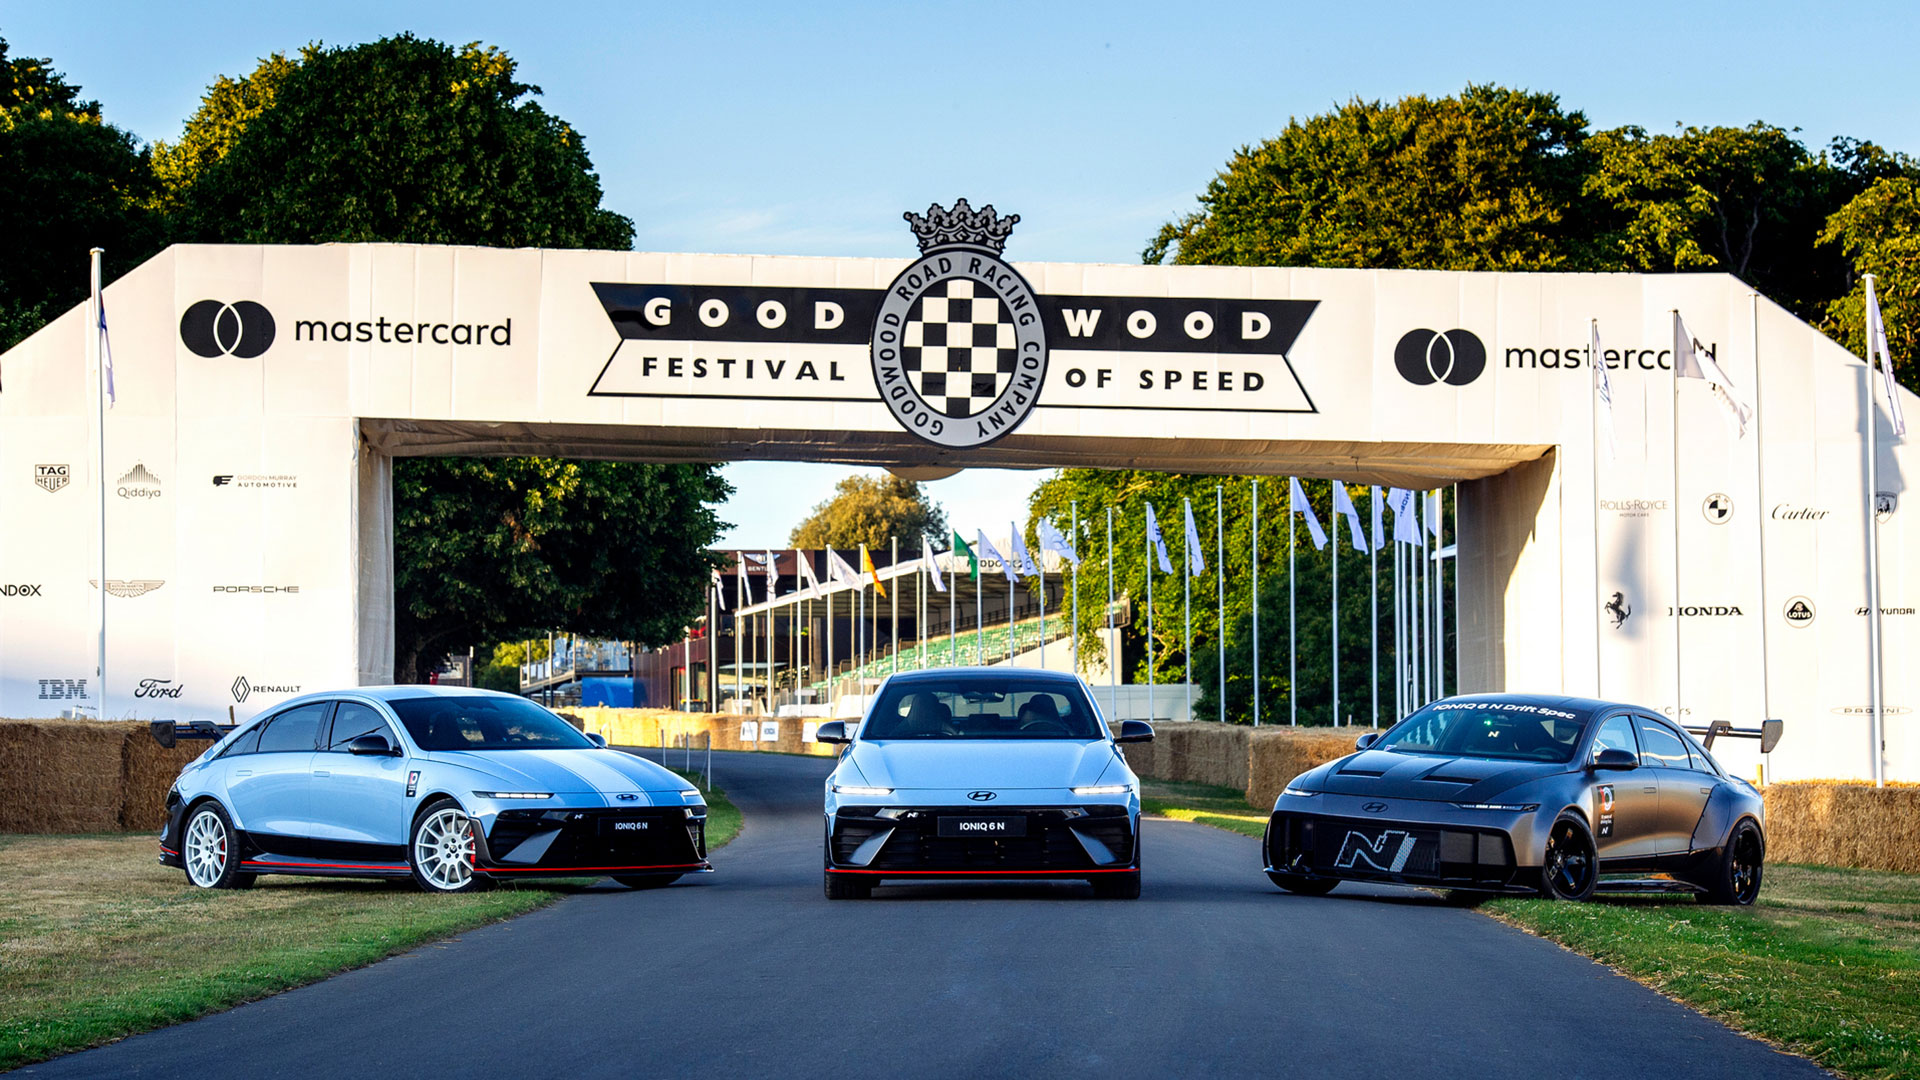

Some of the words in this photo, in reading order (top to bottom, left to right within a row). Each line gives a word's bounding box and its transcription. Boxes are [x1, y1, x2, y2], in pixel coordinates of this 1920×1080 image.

[896, 257, 951, 302] ROAD
[968, 257, 1035, 327] RACING
[643, 297, 845, 330] GOOD
[295, 317, 512, 346] mastercard
[1061, 309, 1272, 340] WOOD
[642, 357, 845, 381] FESTIVAL
[879, 313, 943, 436] GOODWOOD
[1065, 368, 1112, 388] OF
[1139, 369, 1264, 392] SPEED
[976, 341, 1040, 438] COMPANY
[38, 466, 66, 475] TAG
[37, 477, 67, 491] HEUER
[117, 486, 161, 499] Qiddiya
[1600, 499, 1668, 510] ROLLS-ROYCE
[1772, 503, 1830, 520] Cartier
[213, 585, 299, 593] PORSCHE
[1668, 606, 1743, 616] HONDA
[1788, 611, 1811, 619] LOTUS
[1879, 607, 1916, 615] YUNDAI
[38, 679, 87, 699] IBM
[134, 678, 183, 699] Ford
[1433, 703, 1476, 711] IONIQ
[1504, 704, 1535, 713] Drift
[1537, 707, 1576, 720] Spec
[615, 822, 635, 830] IONIQ
[960, 822, 987, 831] IONIQ
[989, 822, 996, 830] 6
[997, 822, 1005, 830] N
